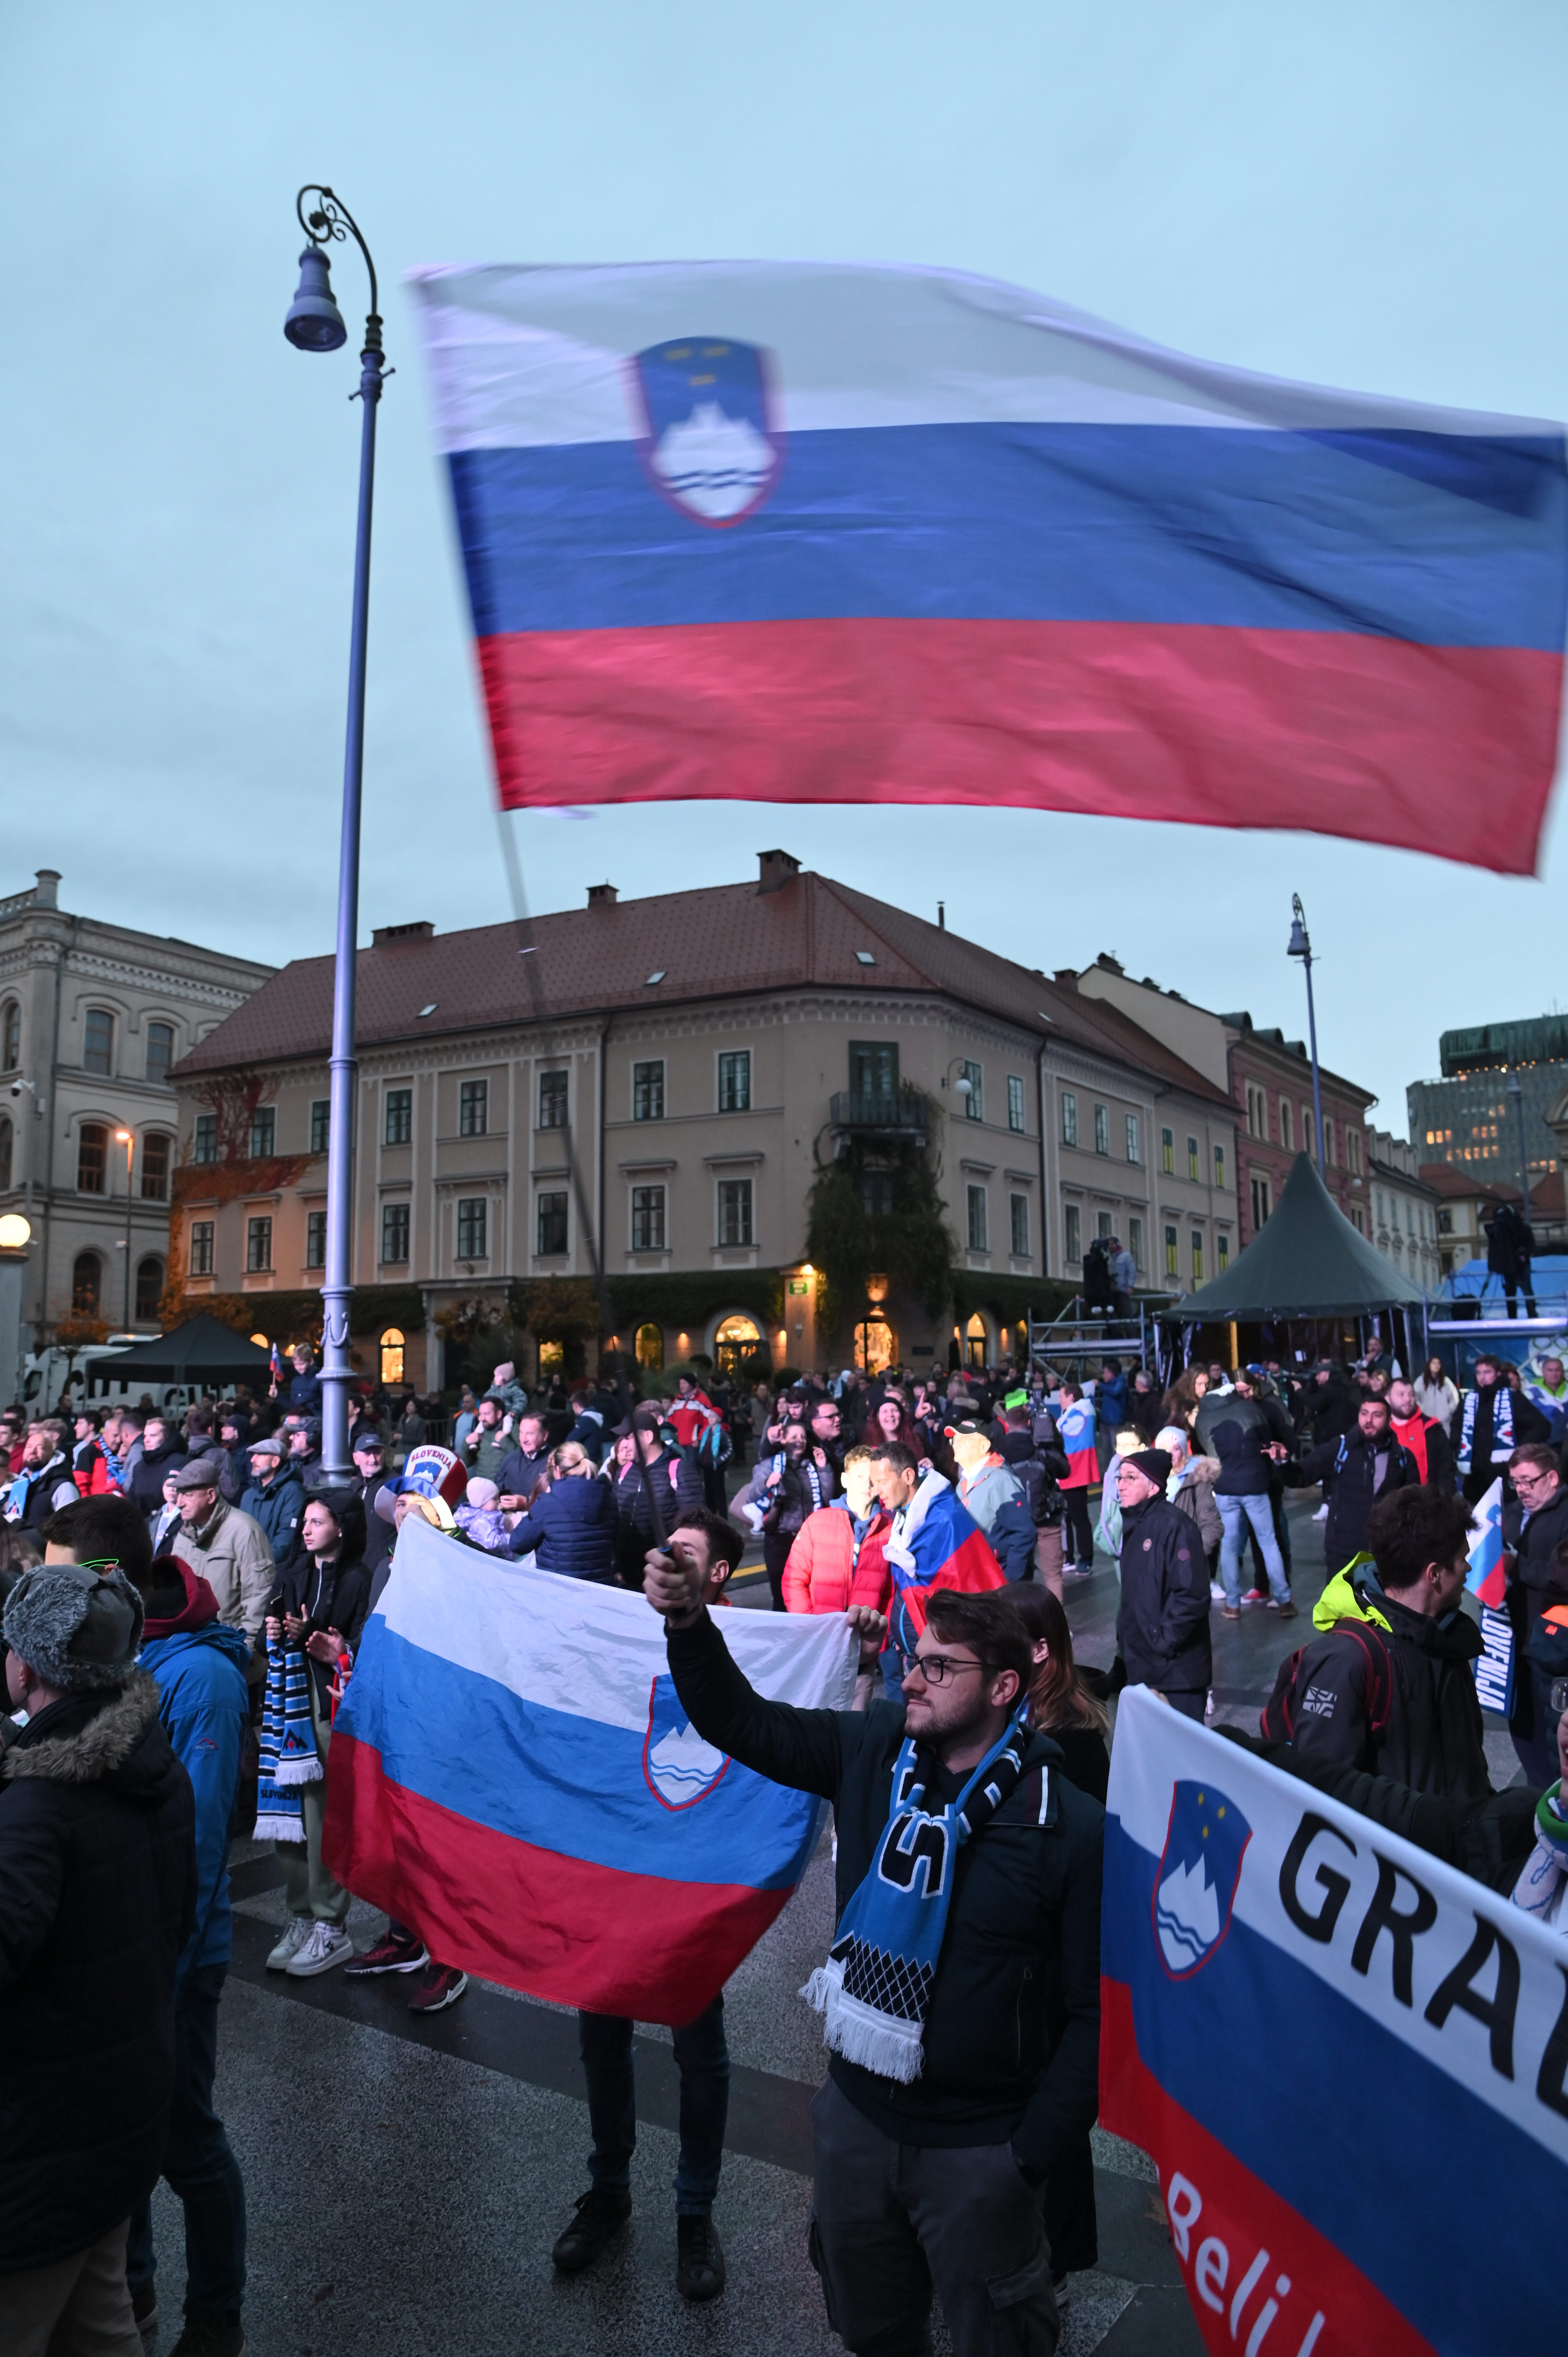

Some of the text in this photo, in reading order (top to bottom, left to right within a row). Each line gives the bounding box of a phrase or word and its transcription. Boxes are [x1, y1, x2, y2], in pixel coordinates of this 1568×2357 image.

[411, 1449, 451, 1470] SLOVENIJA
[261, 1789, 297, 1800] SLOVENIJA
[1168, 2171, 1291, 2357] Beli
